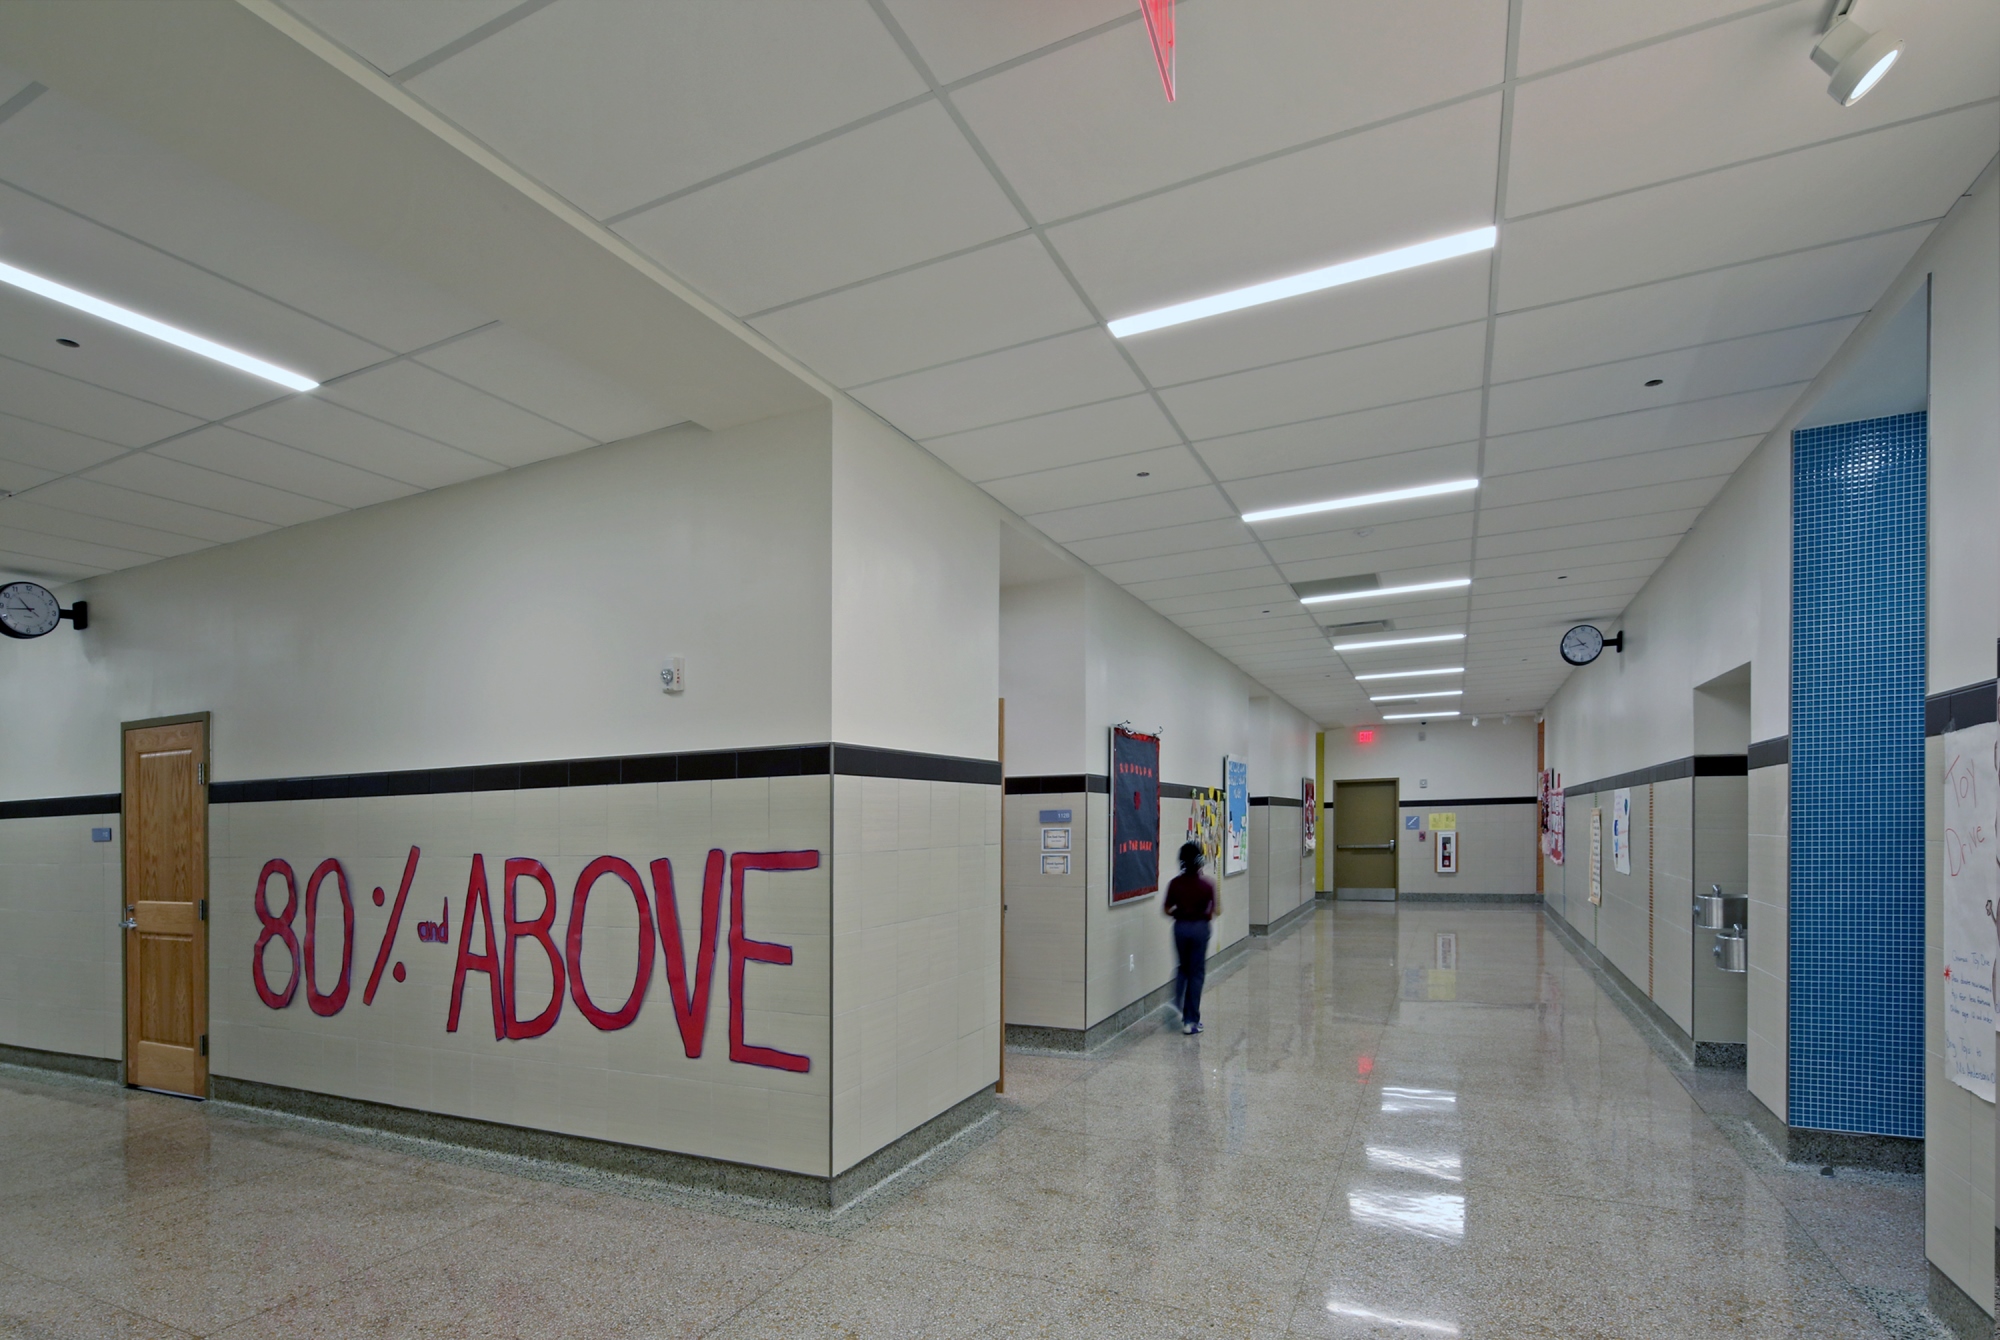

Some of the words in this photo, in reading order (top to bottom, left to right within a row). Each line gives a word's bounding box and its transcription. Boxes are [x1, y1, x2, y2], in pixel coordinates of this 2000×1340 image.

[1359, 731, 1373, 743] EXIT
[1945, 825, 1985, 877] Drive
[417, 896, 449, 944] and
[446, 848, 820, 1073] ABOVE
